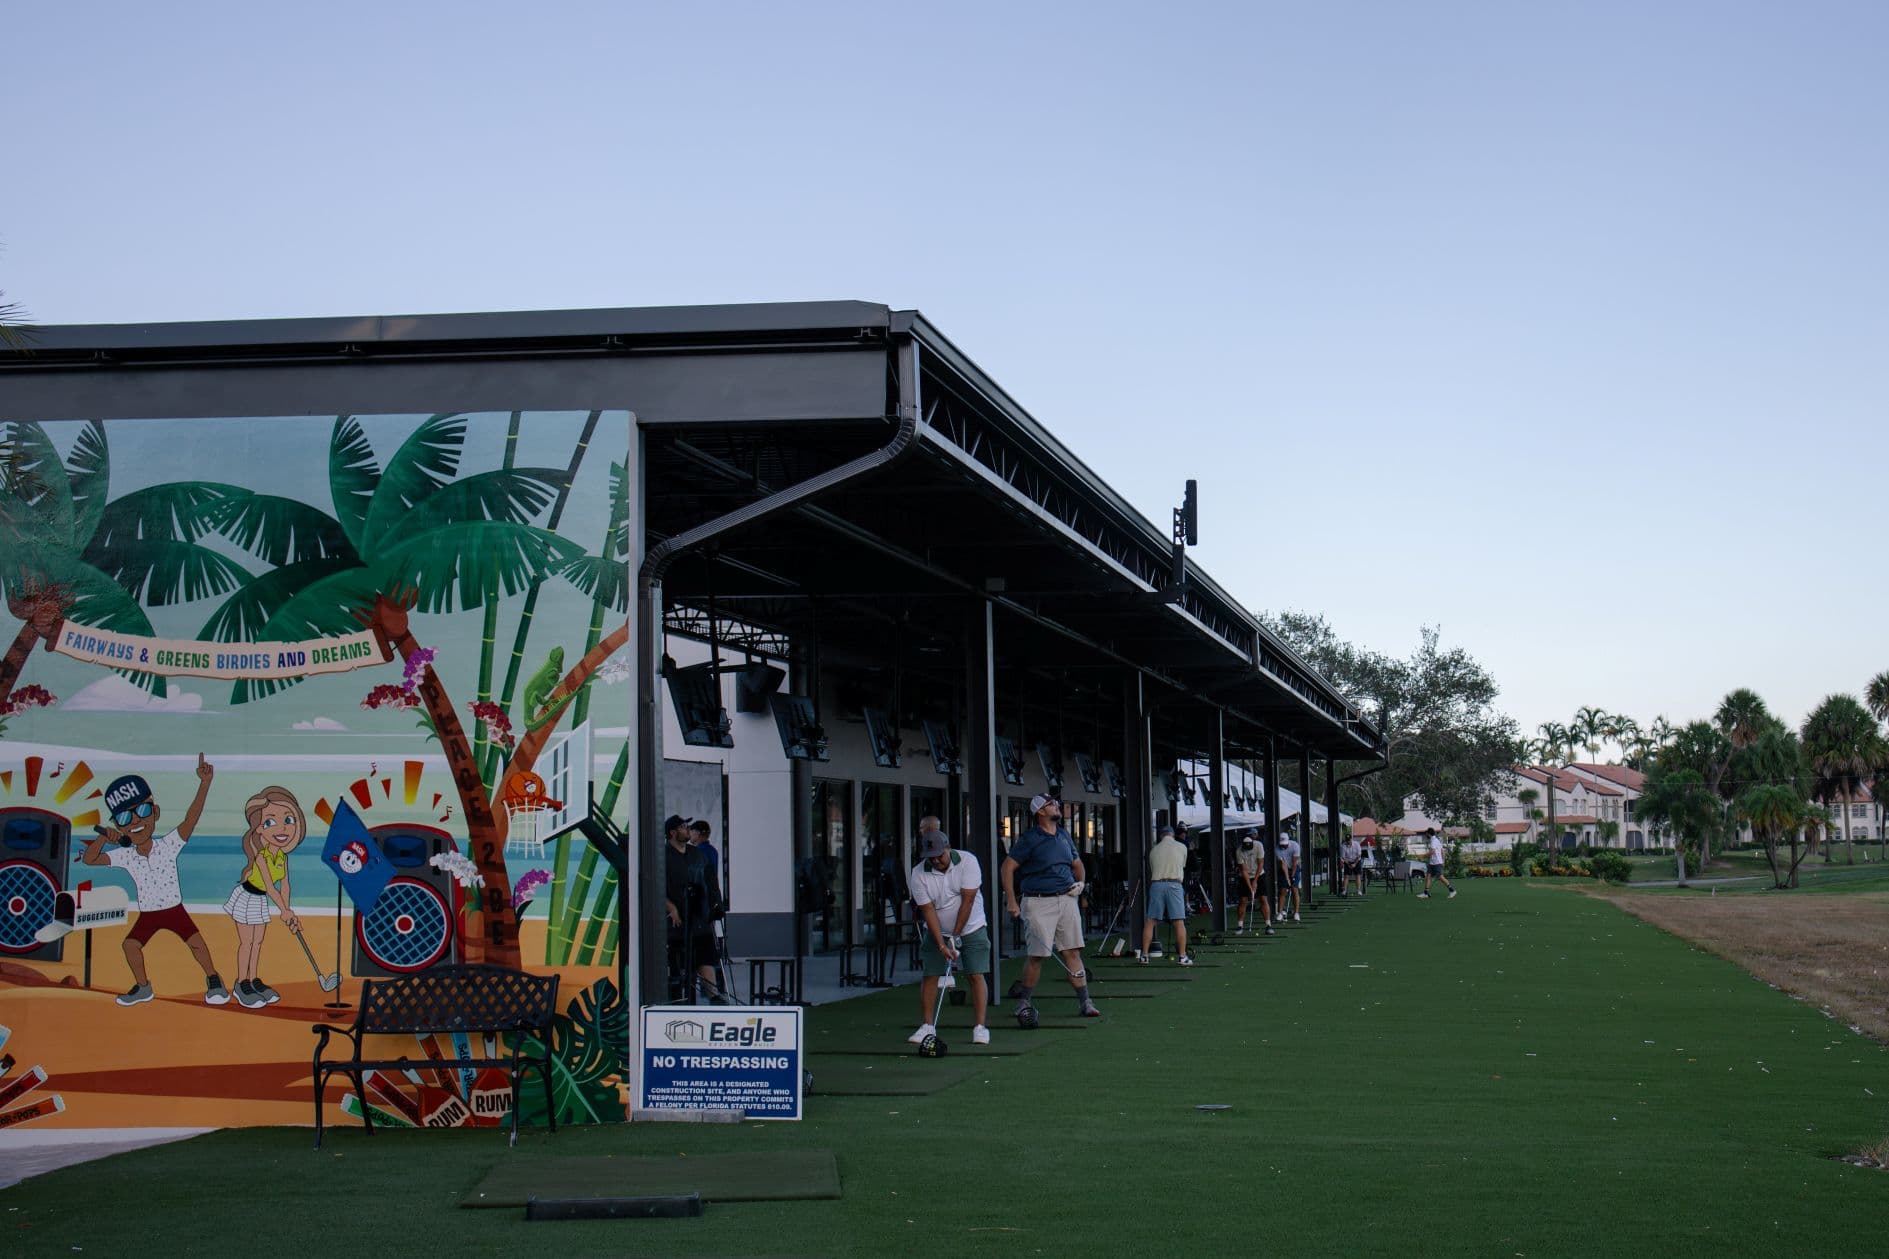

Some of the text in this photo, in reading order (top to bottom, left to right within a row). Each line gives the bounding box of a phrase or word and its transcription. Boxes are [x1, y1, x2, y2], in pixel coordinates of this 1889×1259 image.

[65, 631, 372, 669] FAIRWAYS & GREENS BIRDIES AND DREAMS
[106, 781, 141, 810] NASH
[77, 910, 125, 923] SUGGESTIONS
[710, 1018, 776, 1047] Eagle
[653, 1056, 789, 1069] NO TRESPASSING
[707, 1088, 725, 1096] SITE,
[476, 1093, 512, 1113] RUM
